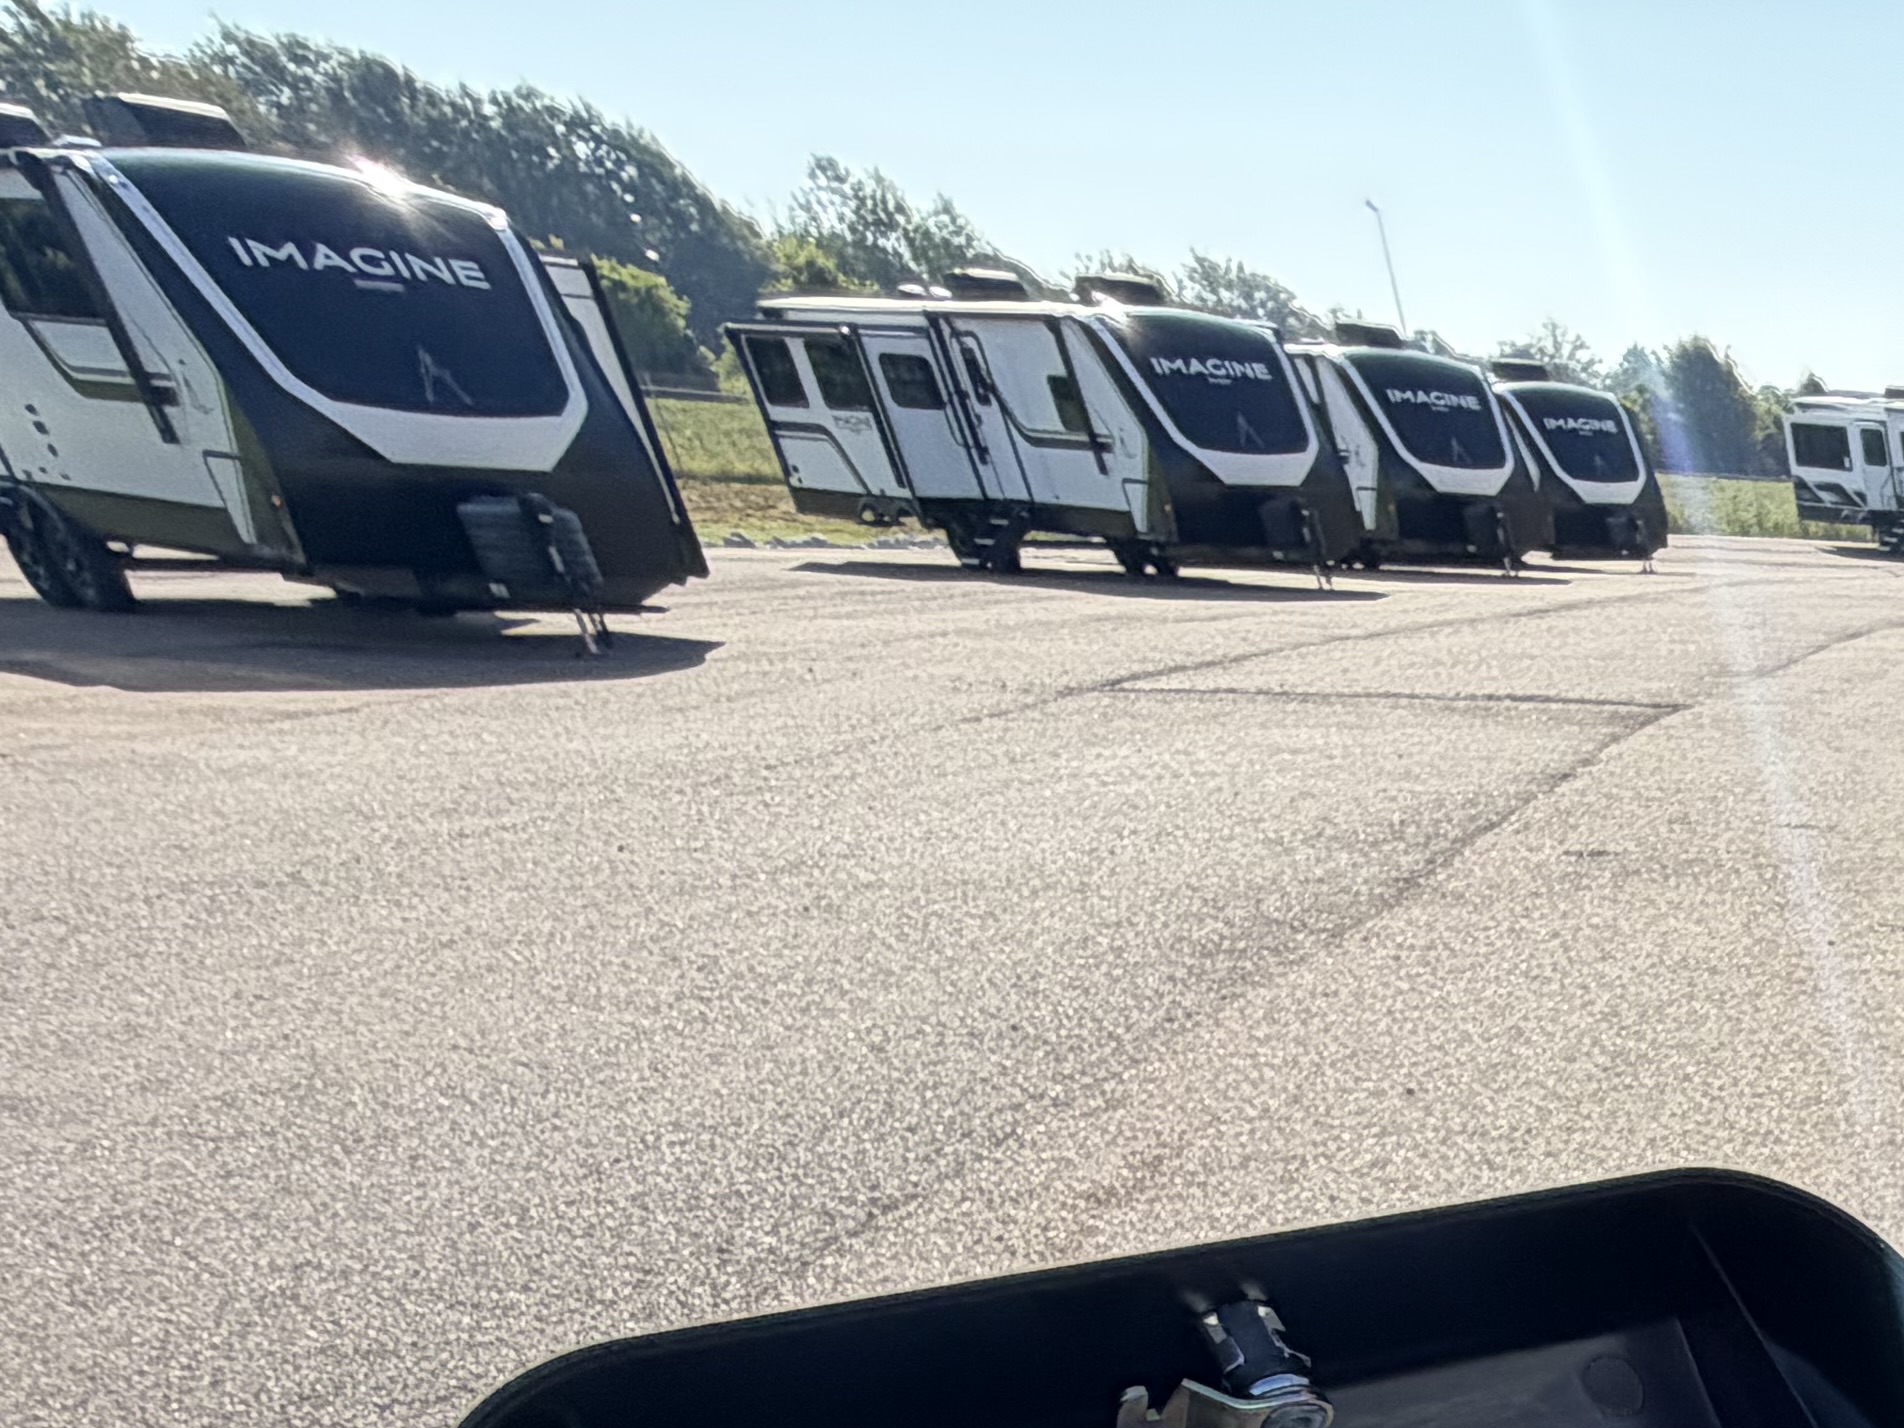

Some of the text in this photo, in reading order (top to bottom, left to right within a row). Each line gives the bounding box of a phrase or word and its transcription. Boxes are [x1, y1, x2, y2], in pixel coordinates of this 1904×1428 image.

[228, 236, 491, 290] IMAGINE
[1150, 357, 1273, 381] IMAGINE
[1386, 389, 1481, 411] IMAGINE
[1543, 417, 1618, 434] IMAGINE
